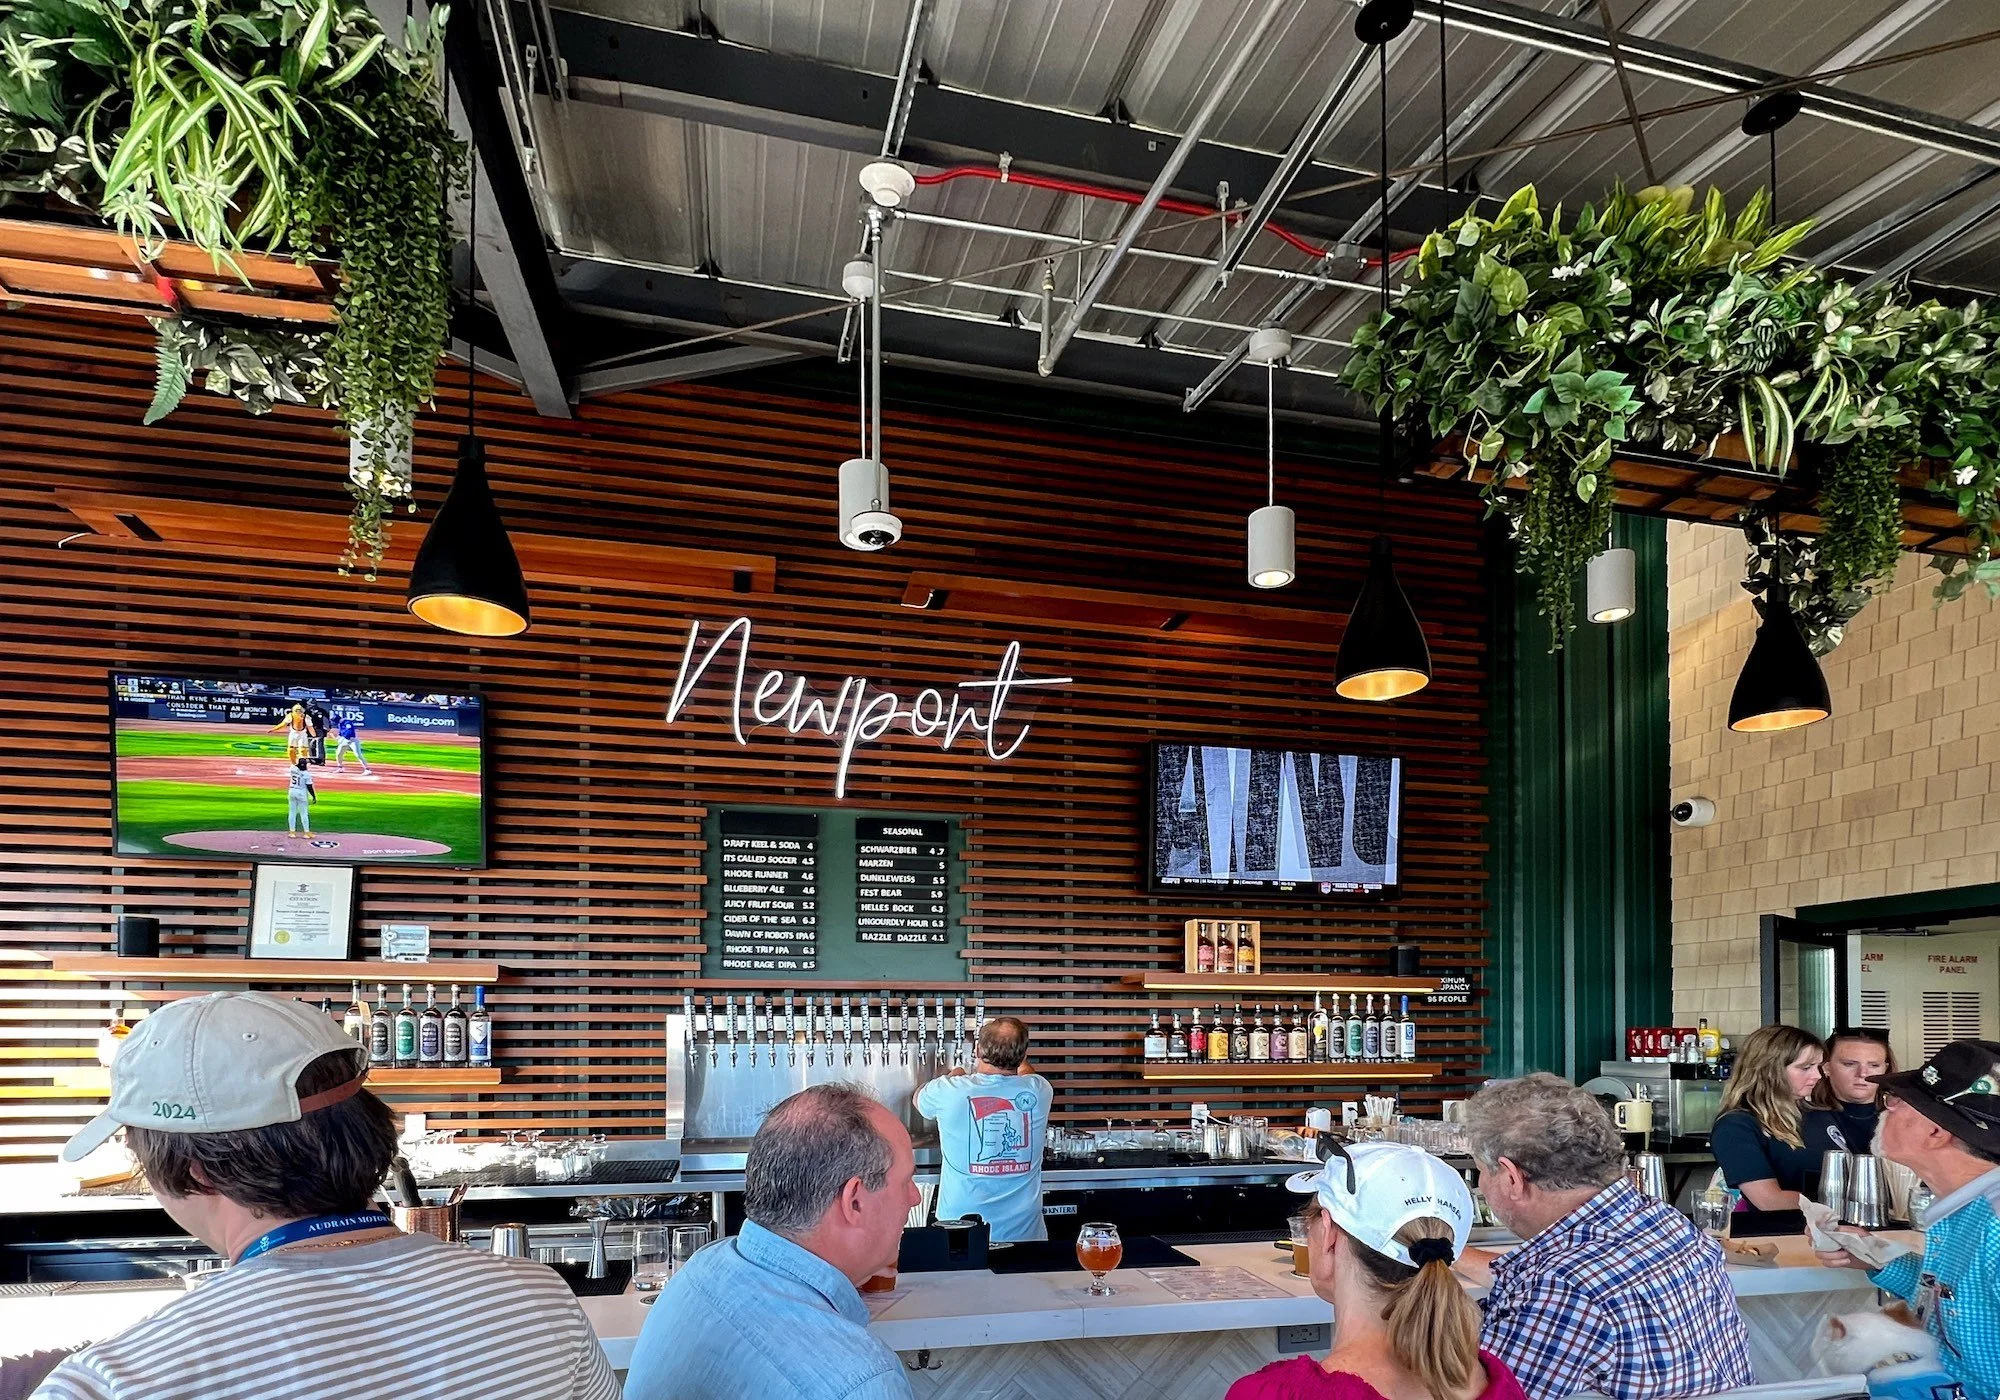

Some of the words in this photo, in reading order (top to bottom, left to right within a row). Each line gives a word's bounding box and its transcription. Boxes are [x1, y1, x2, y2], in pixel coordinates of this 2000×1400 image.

[166, 702, 204, 710] CONSIDER
[665, 616, 1074, 800] Newport
[387, 714, 455, 727] Booking.com
[883, 828, 923, 836] SEASONAL
[723, 840, 750, 848] DRAFT
[861, 846, 917, 854] SCHWARZBIER
[737, 855, 766, 863] CALLED
[768, 856, 797, 864] SOCCER
[724, 870, 753, 878] RHODE
[755, 871, 788, 879] RUNNER
[860, 875, 915, 883] DUNKLEWEISS
[769, 885, 784, 893] ALE
[893, 904, 914, 912] BOCK
[858, 918, 905, 926] UNGOURDLY
[1928, 955, 1947, 963] FIRE
[1949, 956, 1978, 964] ALARM
[1939, 966, 1967, 974] PANEL
[785, 1005, 794, 1039] NEWPORT
[824, 1005, 833, 1039] NEWPORT
[842, 1005, 851, 1040] NEWPORT
[861, 1005, 870, 1039] NEWPORT
[917, 1005, 926, 1039] NEWPORT
[936, 1005, 944, 1039] NEWPORT
[152, 1101, 196, 1120] 2024
[972, 1165, 999, 1173] RHODE
[1002, 1163, 1029, 1172] ISLAND
[1404, 1196, 1432, 1206] HELLY
[308, 1216, 356, 1232] AUDRAIN
